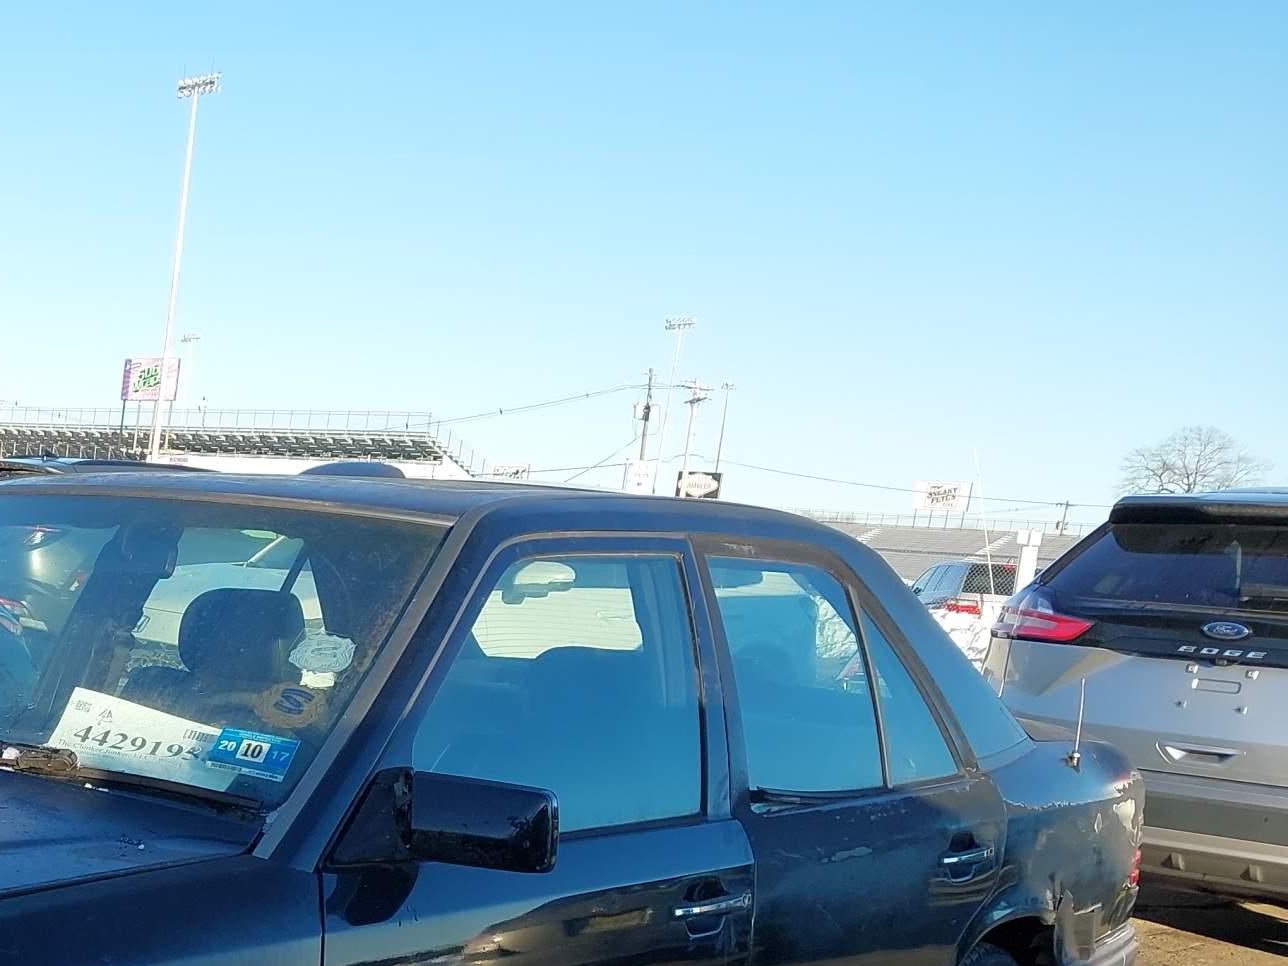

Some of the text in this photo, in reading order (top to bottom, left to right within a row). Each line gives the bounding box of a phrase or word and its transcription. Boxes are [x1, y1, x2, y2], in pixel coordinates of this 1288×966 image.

[1177, 645, 1268, 659] EDGE
[218, 740, 290, 761] 20 10 17
